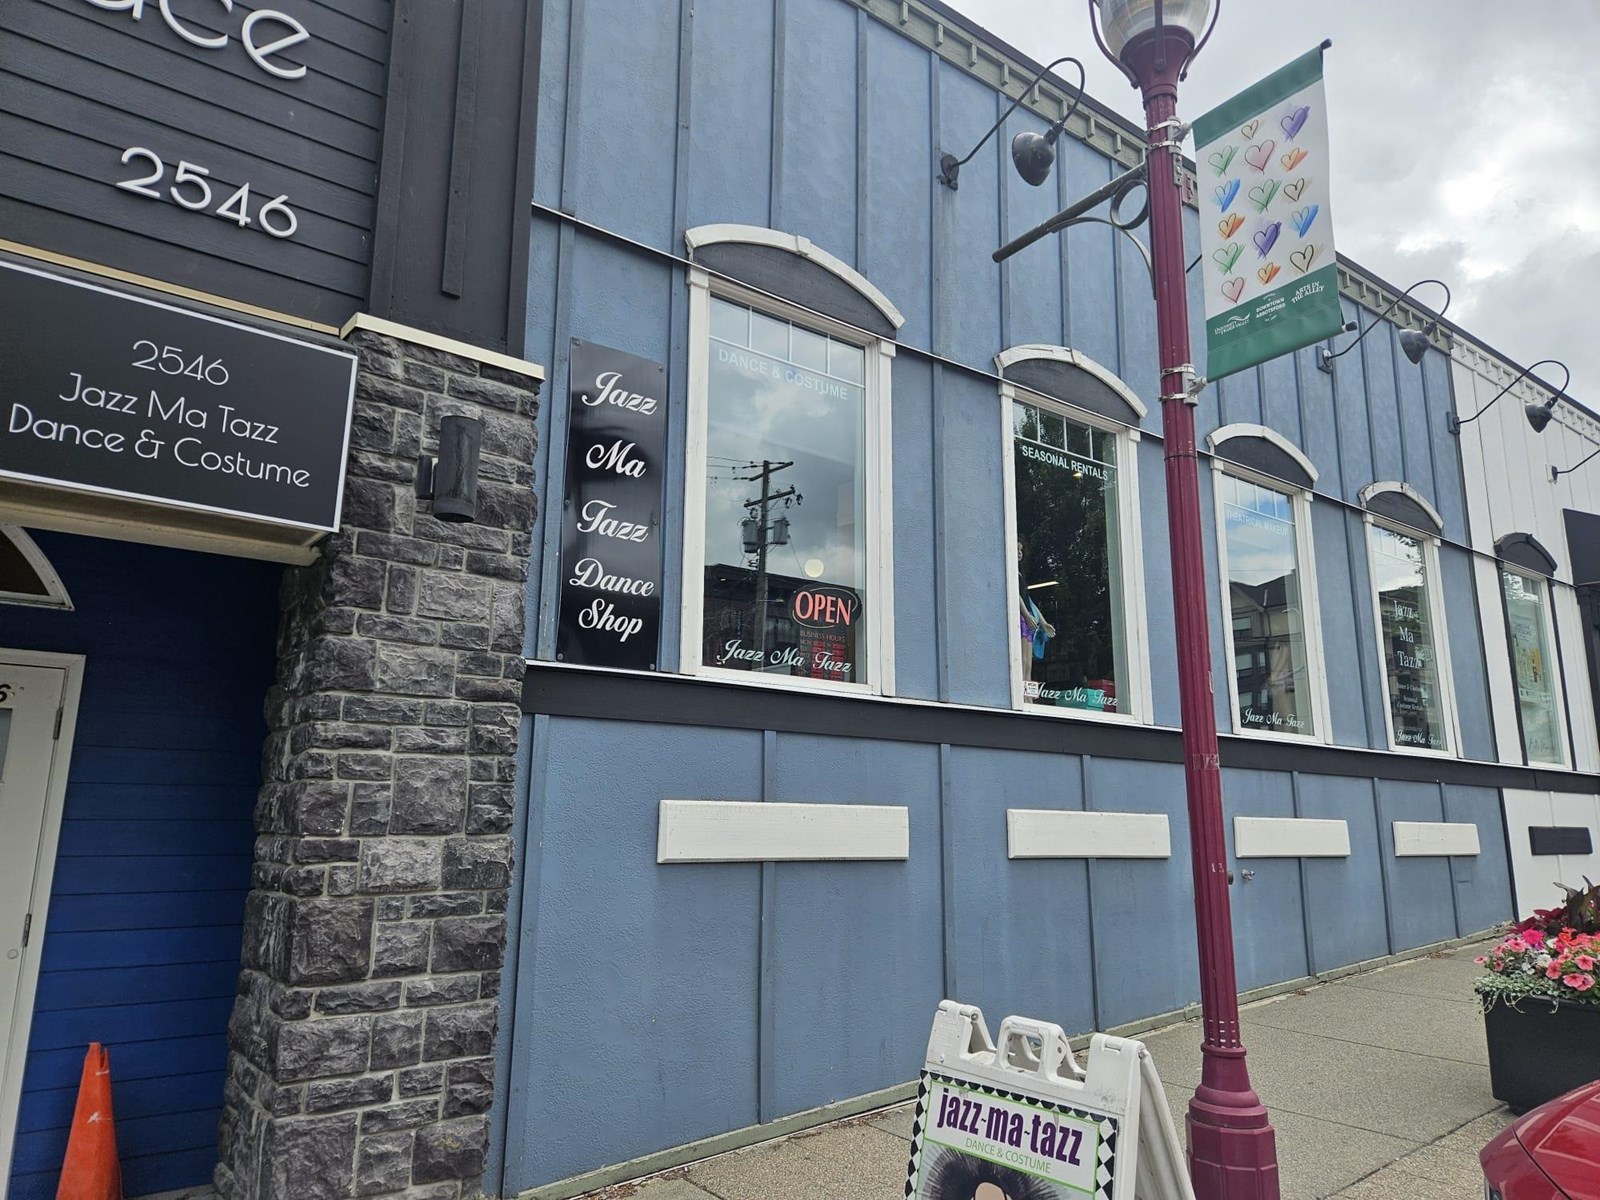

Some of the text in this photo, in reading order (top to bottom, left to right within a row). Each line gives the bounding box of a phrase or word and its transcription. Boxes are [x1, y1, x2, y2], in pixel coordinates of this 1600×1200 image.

[116, 147, 298, 238] 2546
[1256, 297, 1285, 312] DOWNTOWN
[1292, 285, 1325, 304] THE ALLEY
[1296, 281, 1320, 296] ARTS IN
[1256, 303, 1286, 318] ABBOTSFORD
[131, 340, 229, 385] 2546
[719, 348, 848, 400] DANCE & COSTUME
[59, 372, 279, 444] Jazz Ma Tazz
[581, 371, 658, 416] Jazz
[9, 403, 311, 487] Dance & Costume
[585, 439, 646, 478] Ma
[1022, 445, 1108, 480] SEASONAL RENTALS
[576, 499, 649, 543] Tazz
[569, 557, 654, 597] Dance
[578, 598, 643, 642] Shop
[795, 591, 851, 625] OPEN
[1394, 600, 1414, 618] Jazz
[1399, 626, 1414, 643] Ma
[717, 639, 765, 662] Jazz
[770, 646, 804, 667] Ma
[813, 651, 852, 673] Tazz
[1397, 651, 1422, 669] Tazz
[1064, 687, 1087, 702] Ma
[1093, 689, 1119, 706] Tazz
[1242, 708, 1304, 728] Jazz Ma Tazz
[966, 1138, 1051, 1174] DANCE & COSTUME
